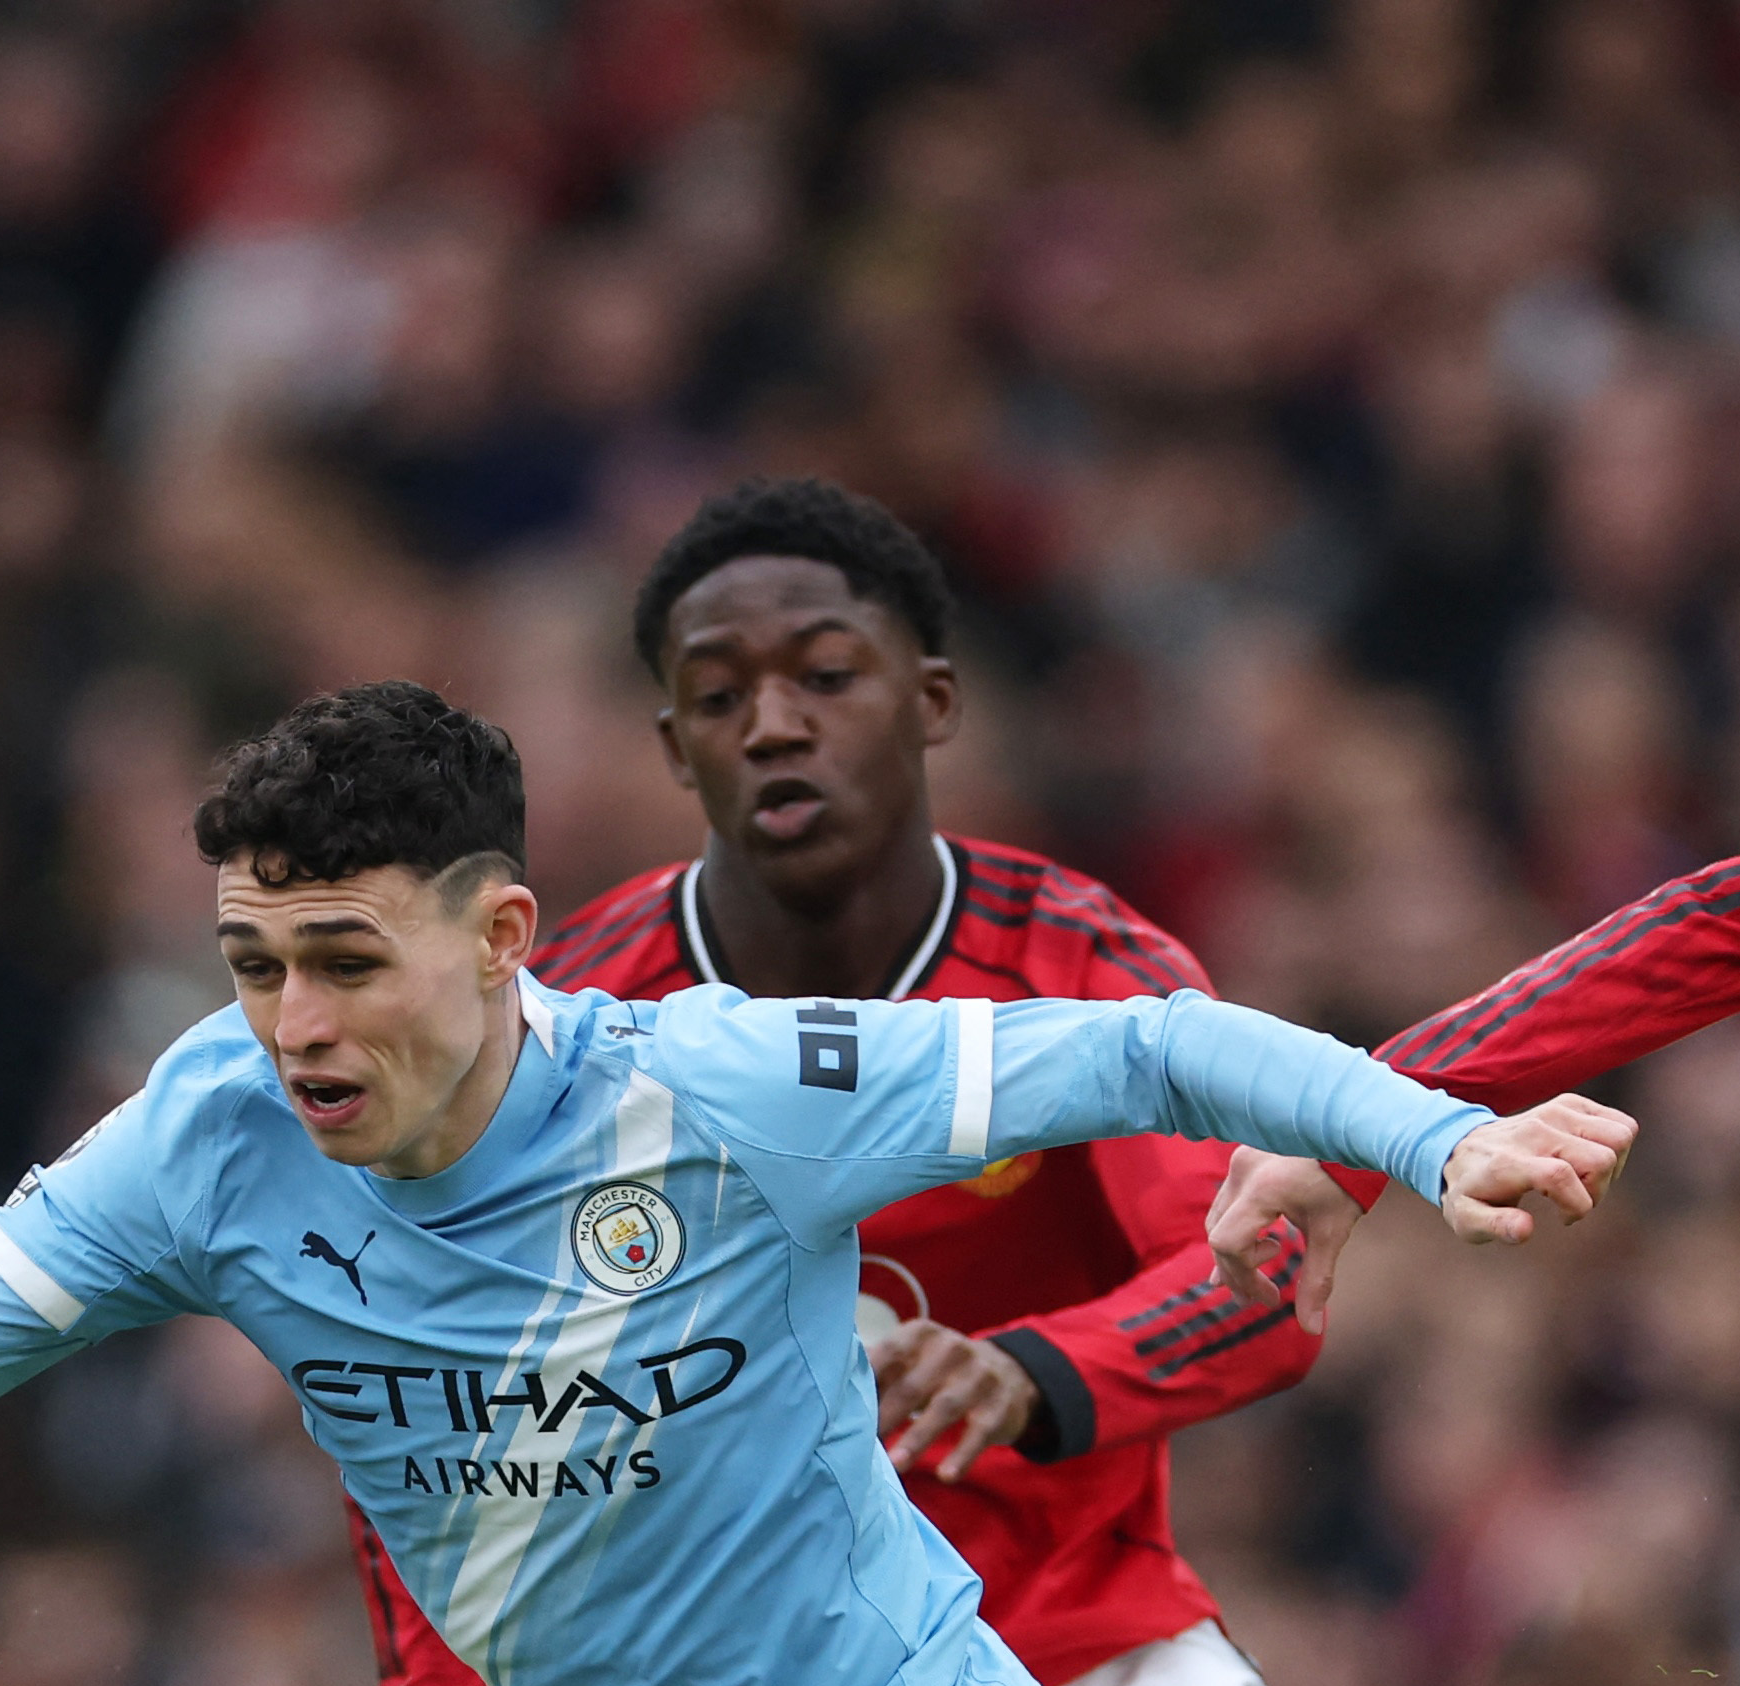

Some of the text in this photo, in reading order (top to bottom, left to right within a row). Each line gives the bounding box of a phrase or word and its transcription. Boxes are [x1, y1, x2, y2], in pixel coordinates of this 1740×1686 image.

[580, 1189, 657, 1241] MANCHESTER
[634, 1265, 664, 1287] CITY
[291, 1337, 747, 1433] ETIHAD
[404, 1450, 661, 1498] AIRWAYS
